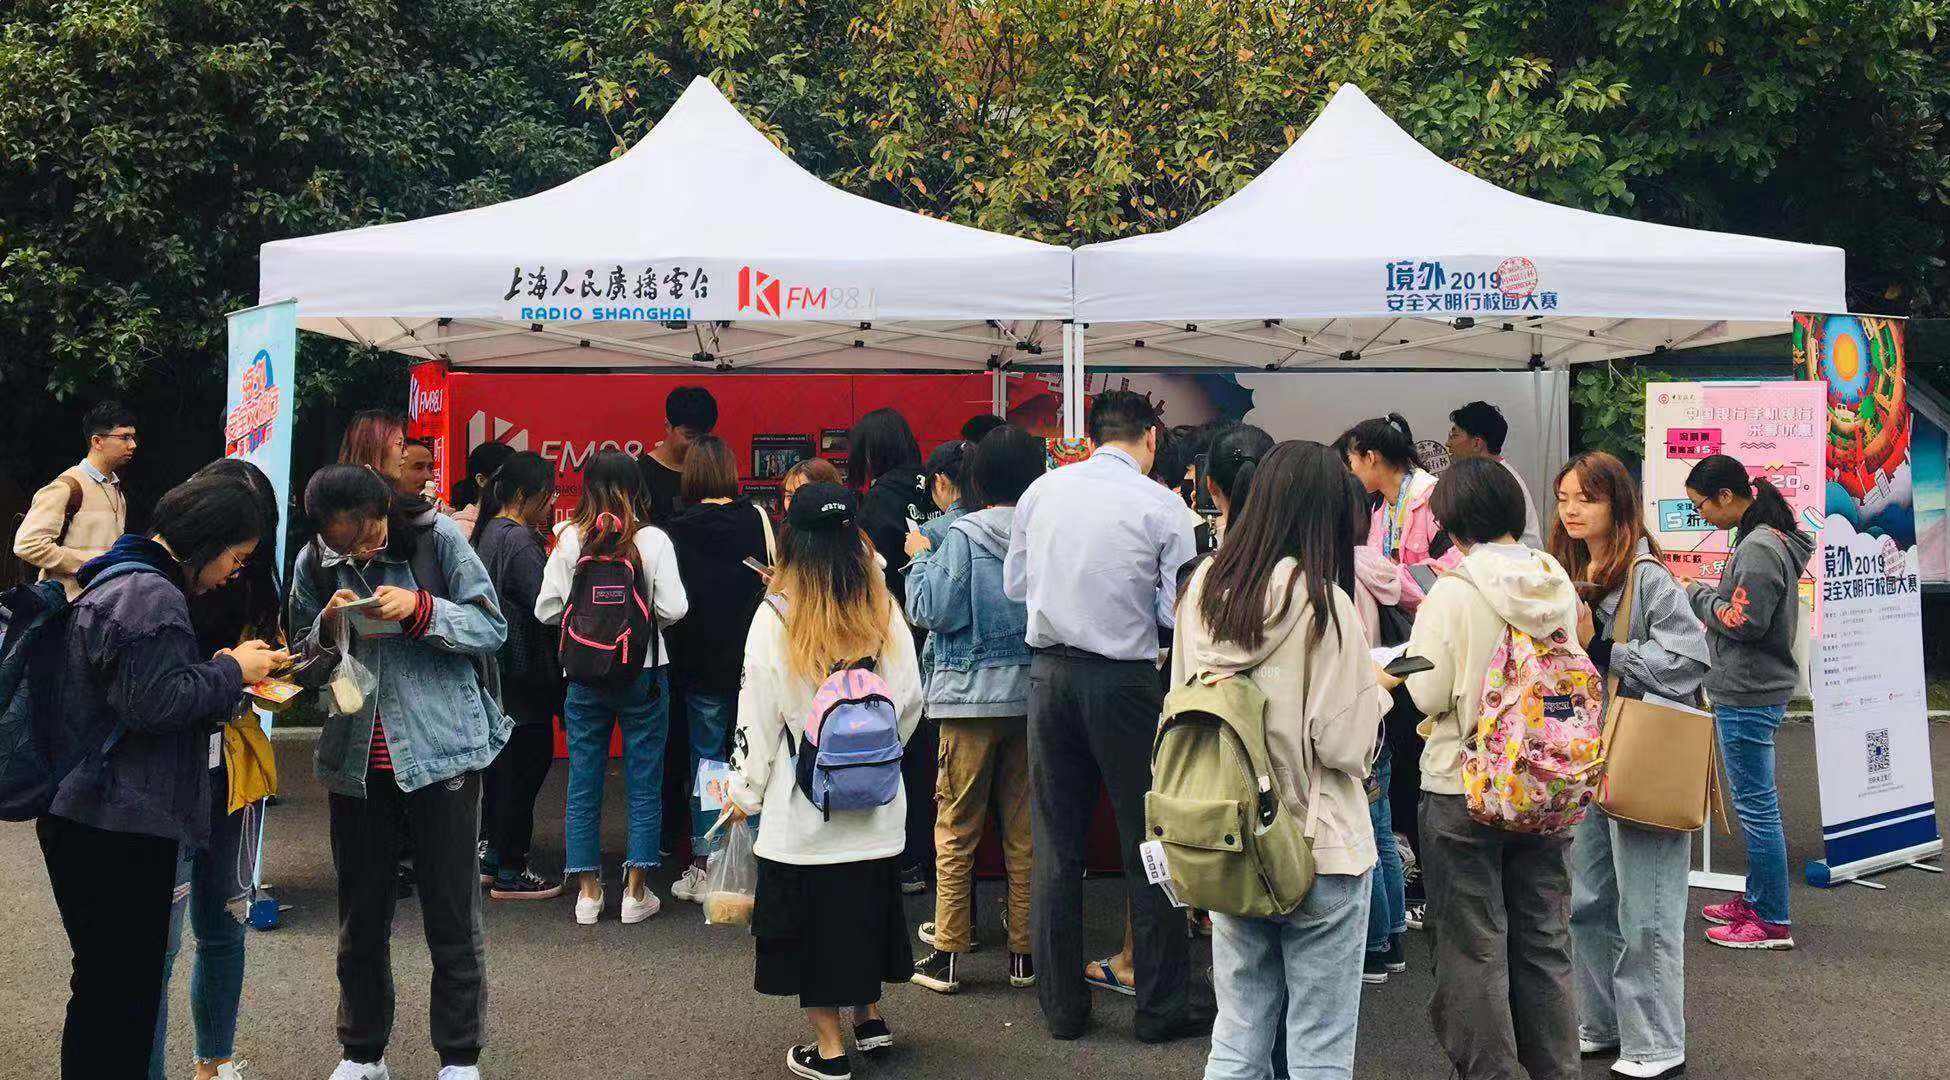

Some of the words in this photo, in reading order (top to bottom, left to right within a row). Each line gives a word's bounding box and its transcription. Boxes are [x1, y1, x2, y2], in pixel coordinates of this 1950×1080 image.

[1385, 260, 1446, 291] 境外
[1451, 272, 1501, 290] 2019
[1386, 292, 1558, 312] 安全文明行校园大赛
[521, 307, 582, 320] RADIO
[592, 307, 691, 320] SHANGHAI
[1854, 554, 1885, 575] 2019
[1823, 573, 1918, 602] 安全文明行校园大赛
